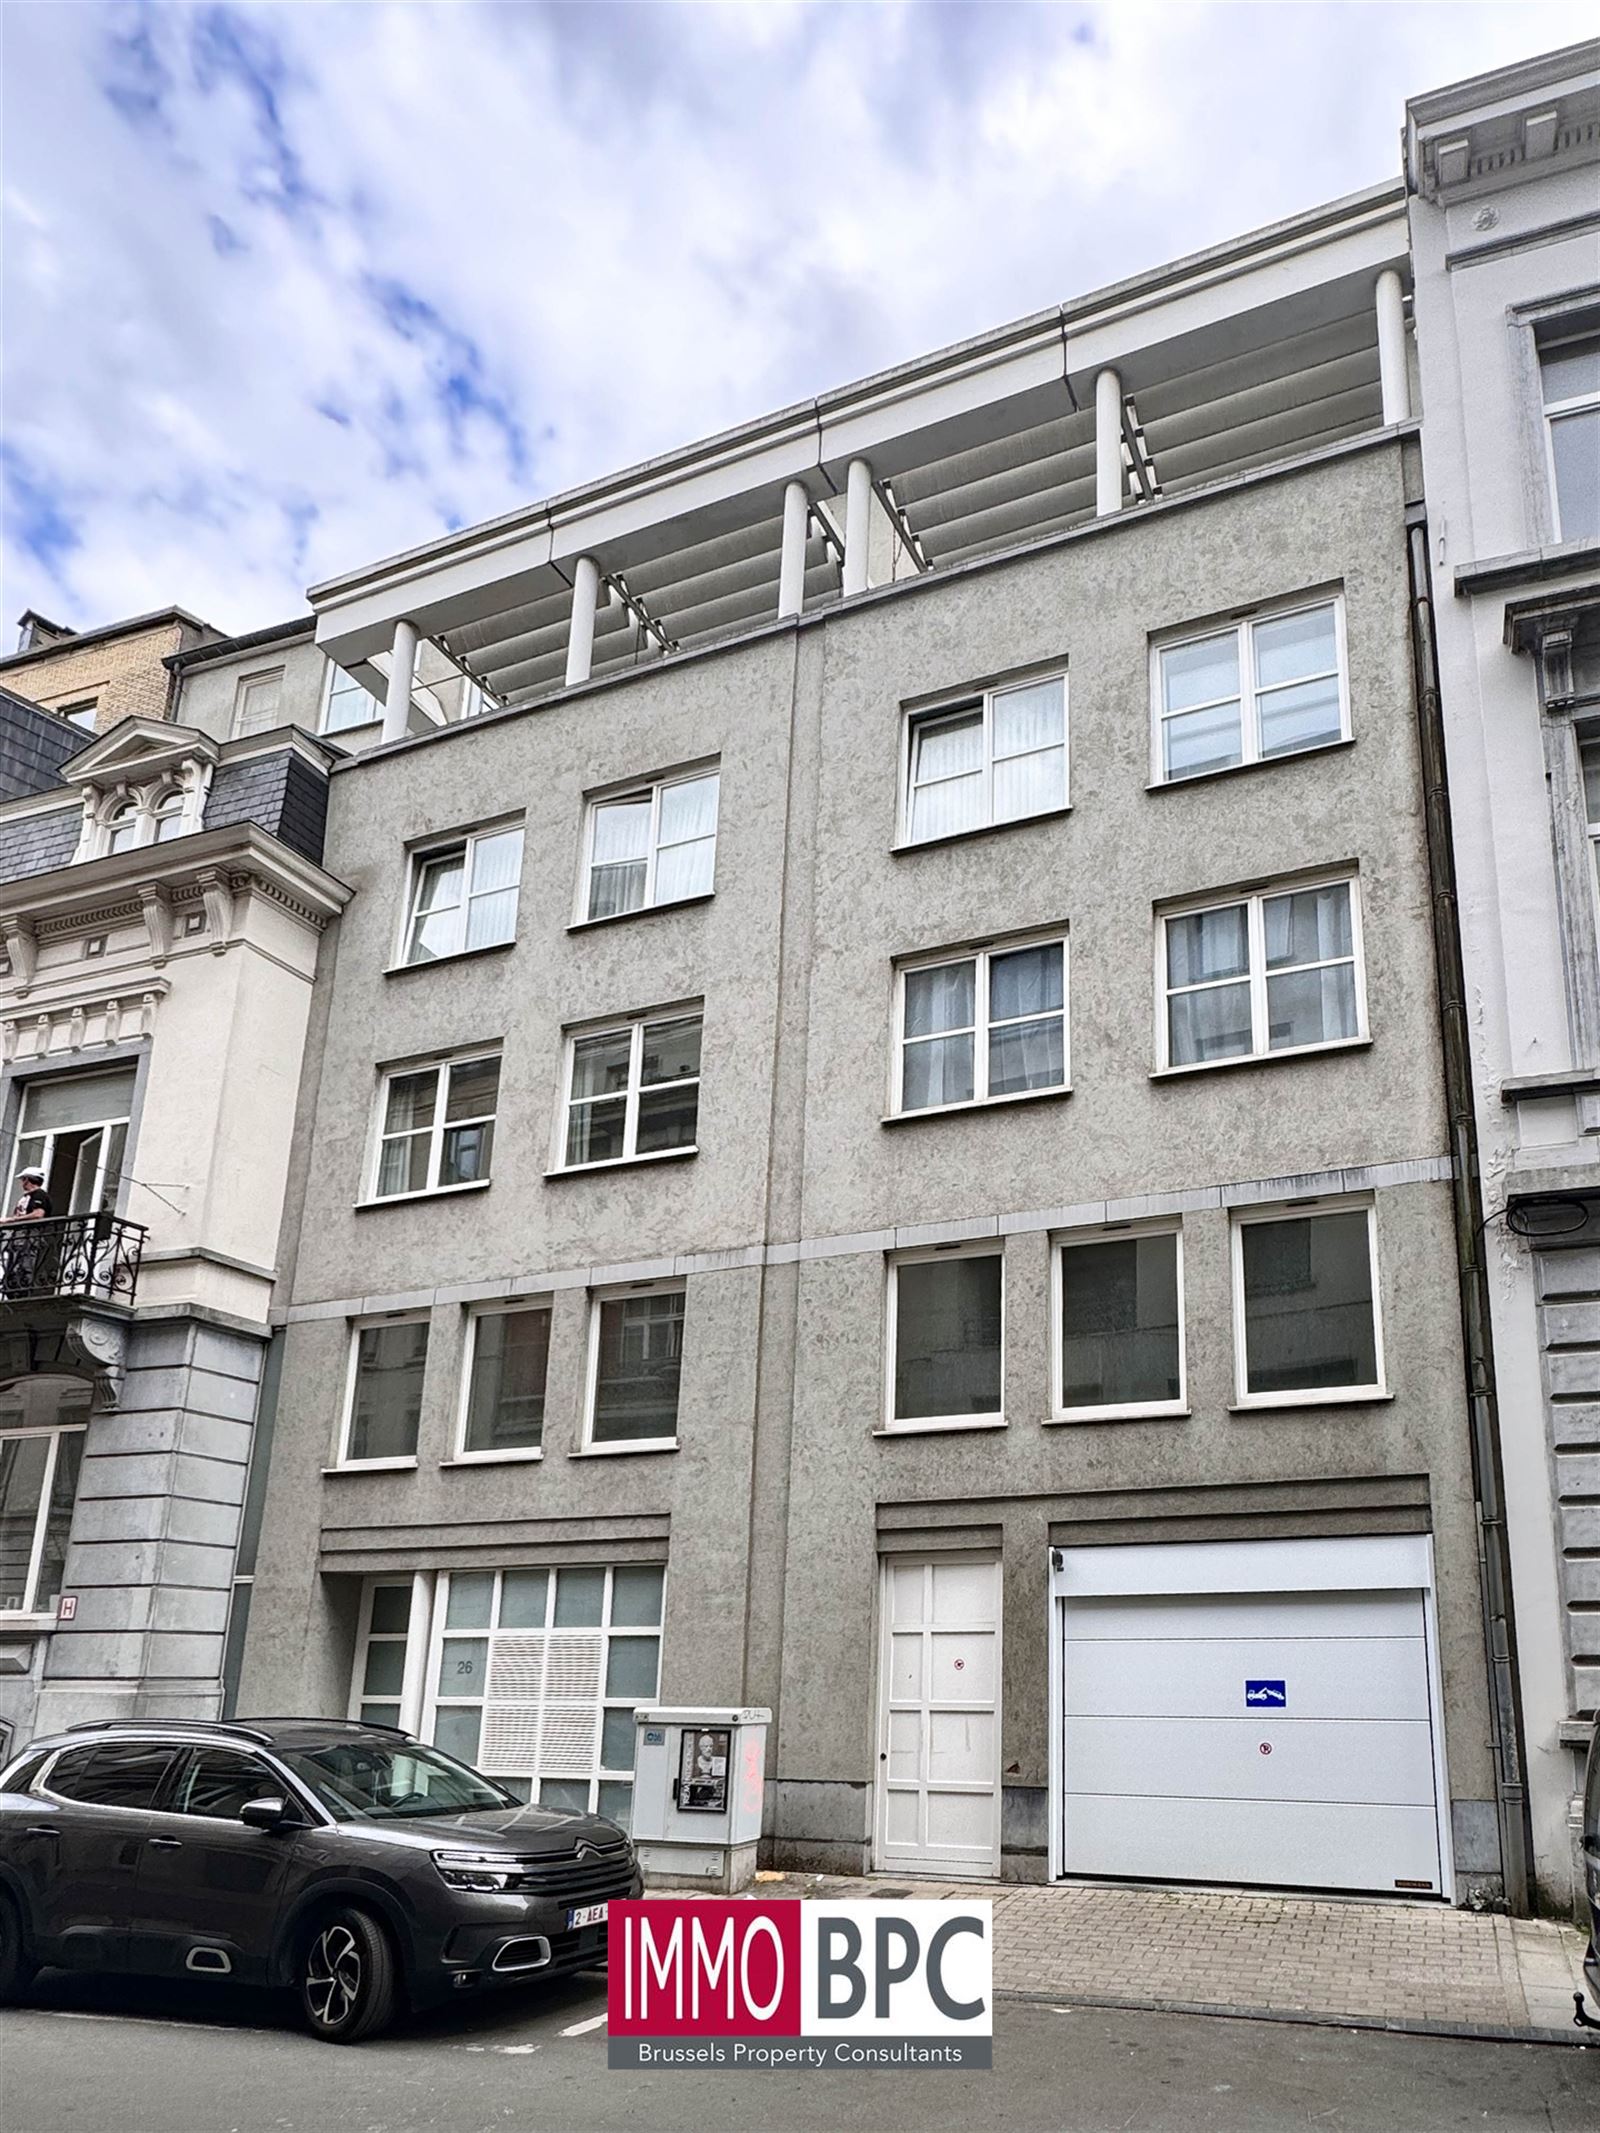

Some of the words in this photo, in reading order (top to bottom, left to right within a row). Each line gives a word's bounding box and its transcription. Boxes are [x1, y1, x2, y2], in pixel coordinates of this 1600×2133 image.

[63, 1600, 74, 1616] H
[457, 1660, 473, 1675] 26
[574, 1905, 608, 1926] 2-AEA-
